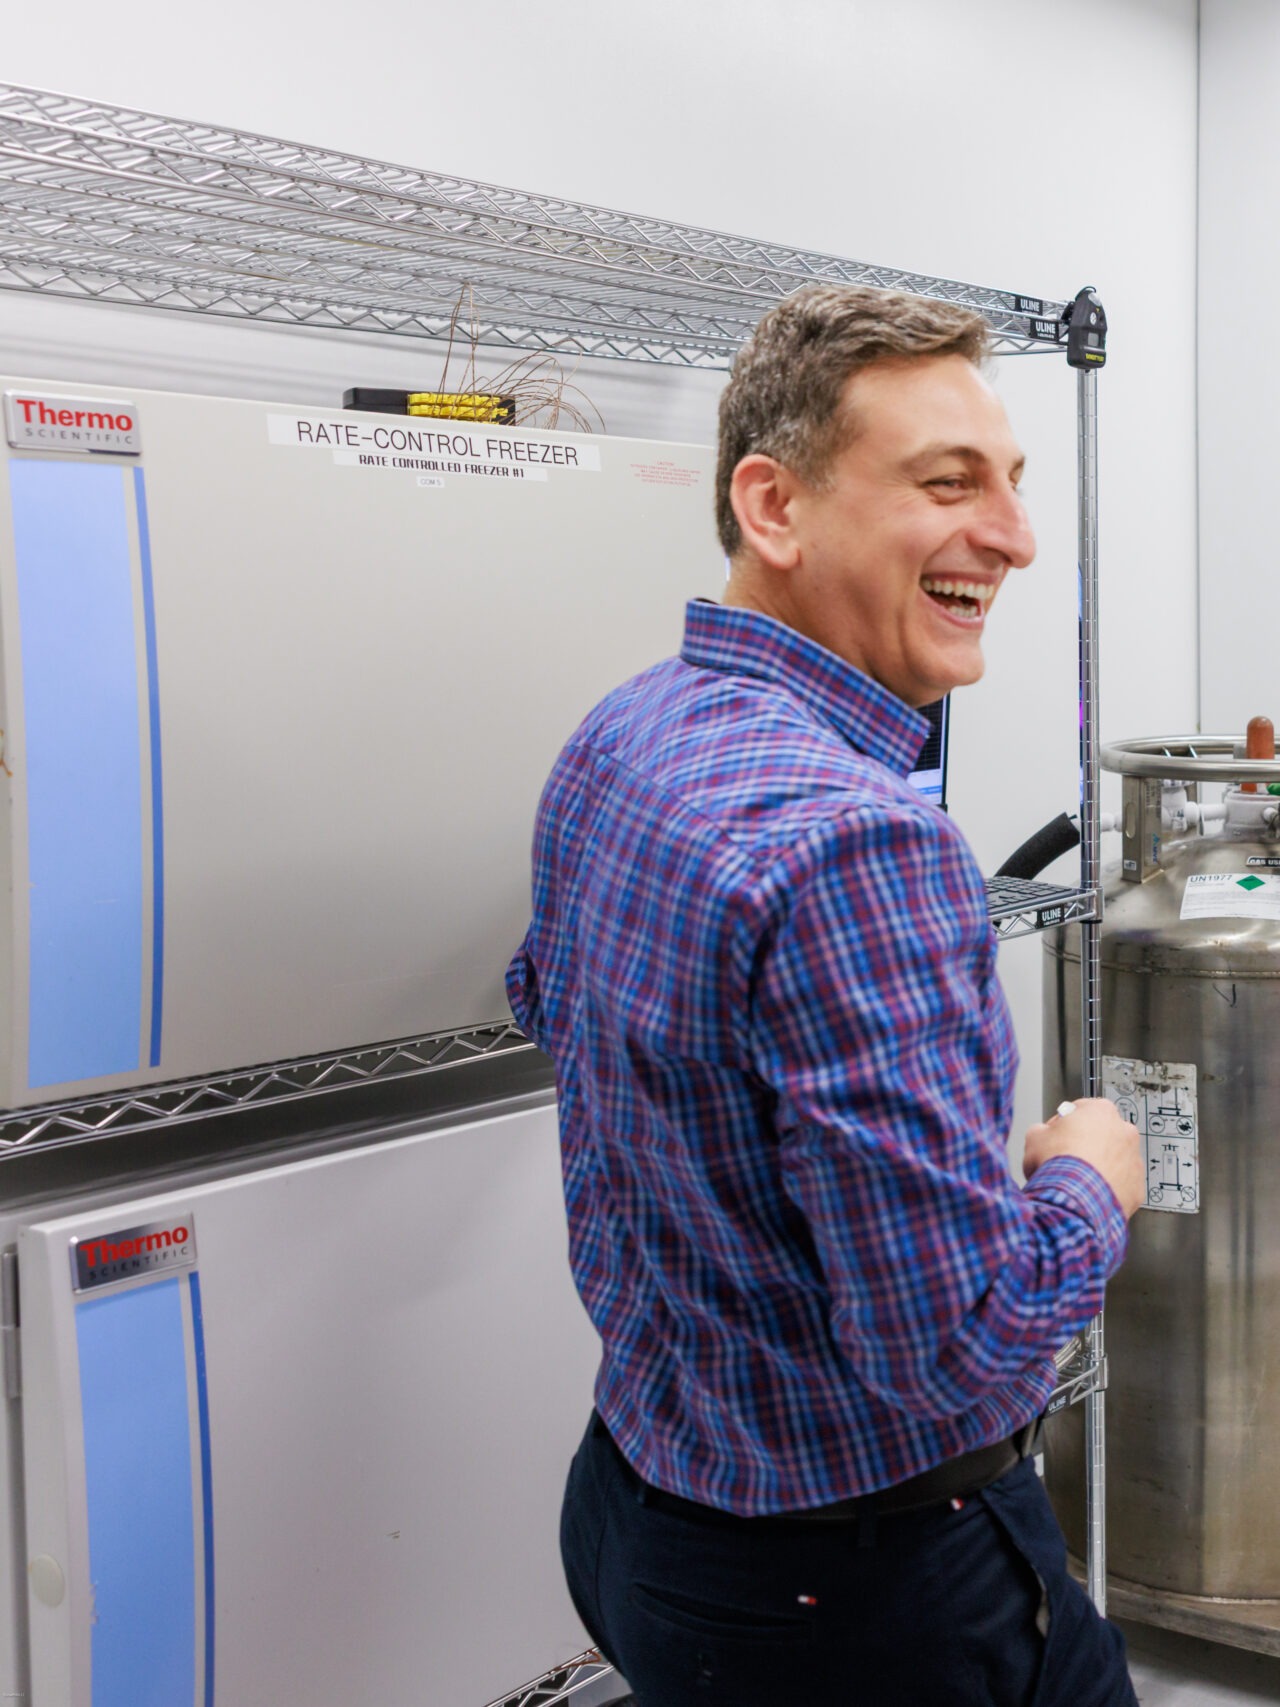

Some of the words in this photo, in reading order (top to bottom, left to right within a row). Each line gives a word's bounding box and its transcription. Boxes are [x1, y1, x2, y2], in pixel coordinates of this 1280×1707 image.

[1020, 298, 1040, 312] ULINE
[1035, 321, 1056, 334] ULINE
[16, 399, 133, 432] Thermo
[25, 427, 133, 445] SCIENTIFIC
[297, 421, 481, 457] RATE-CONTROL
[486, 438, 579, 466] FREEZER
[359, 454, 389, 467] RATE
[392, 457, 461, 473] CONTROLLED
[464, 463, 509, 477] FREEZER
[512, 468, 524, 478] #1
[1249, 858, 1266, 866] GAS
[1190, 874, 1233, 882] UN1977
[1042, 907, 1062, 921] ULINE
[80, 1226, 188, 1268] Thermo
[89, 1246, 188, 1280] SCIENTIFIC
